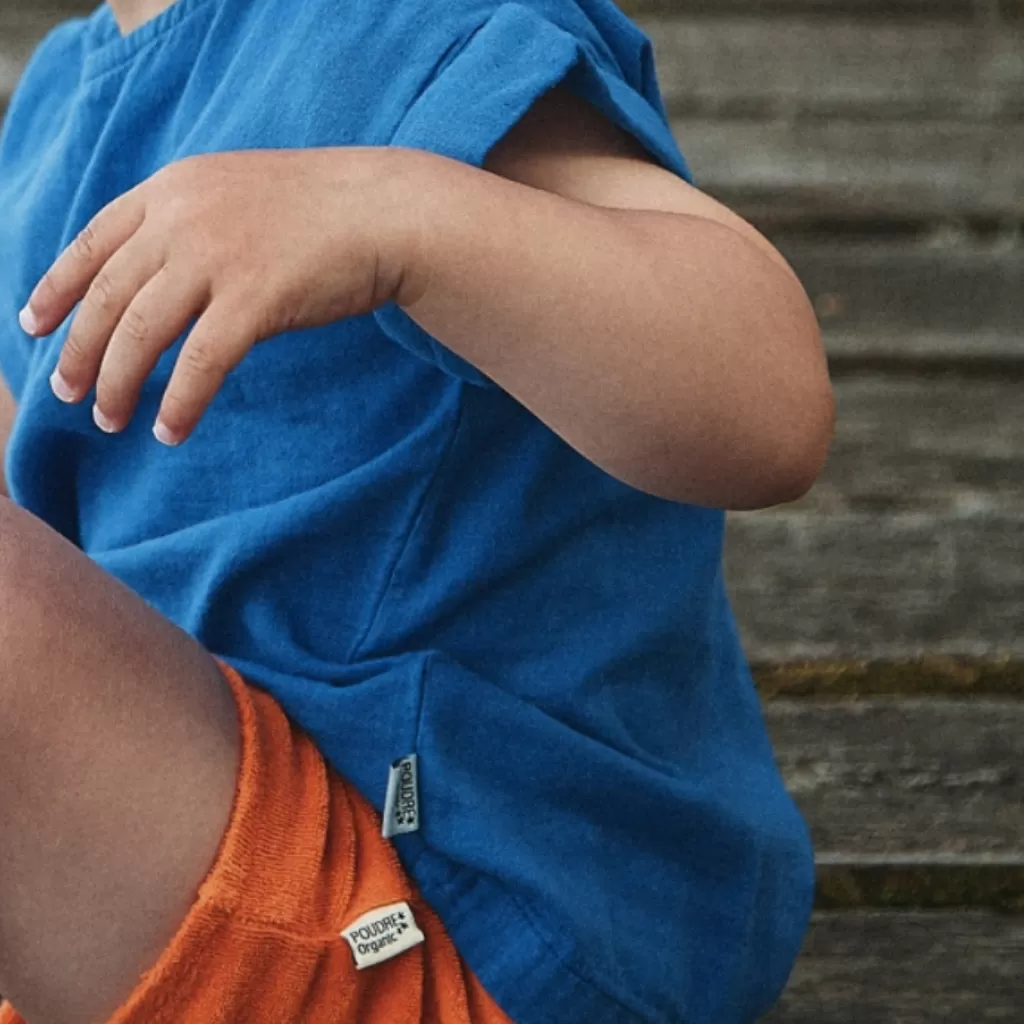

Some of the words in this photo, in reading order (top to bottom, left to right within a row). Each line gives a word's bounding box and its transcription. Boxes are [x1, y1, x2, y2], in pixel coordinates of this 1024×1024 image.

[401, 762, 416, 817] POUDRE
[349, 913, 398, 944] POUDRE
[357, 932, 398, 955] Organic
